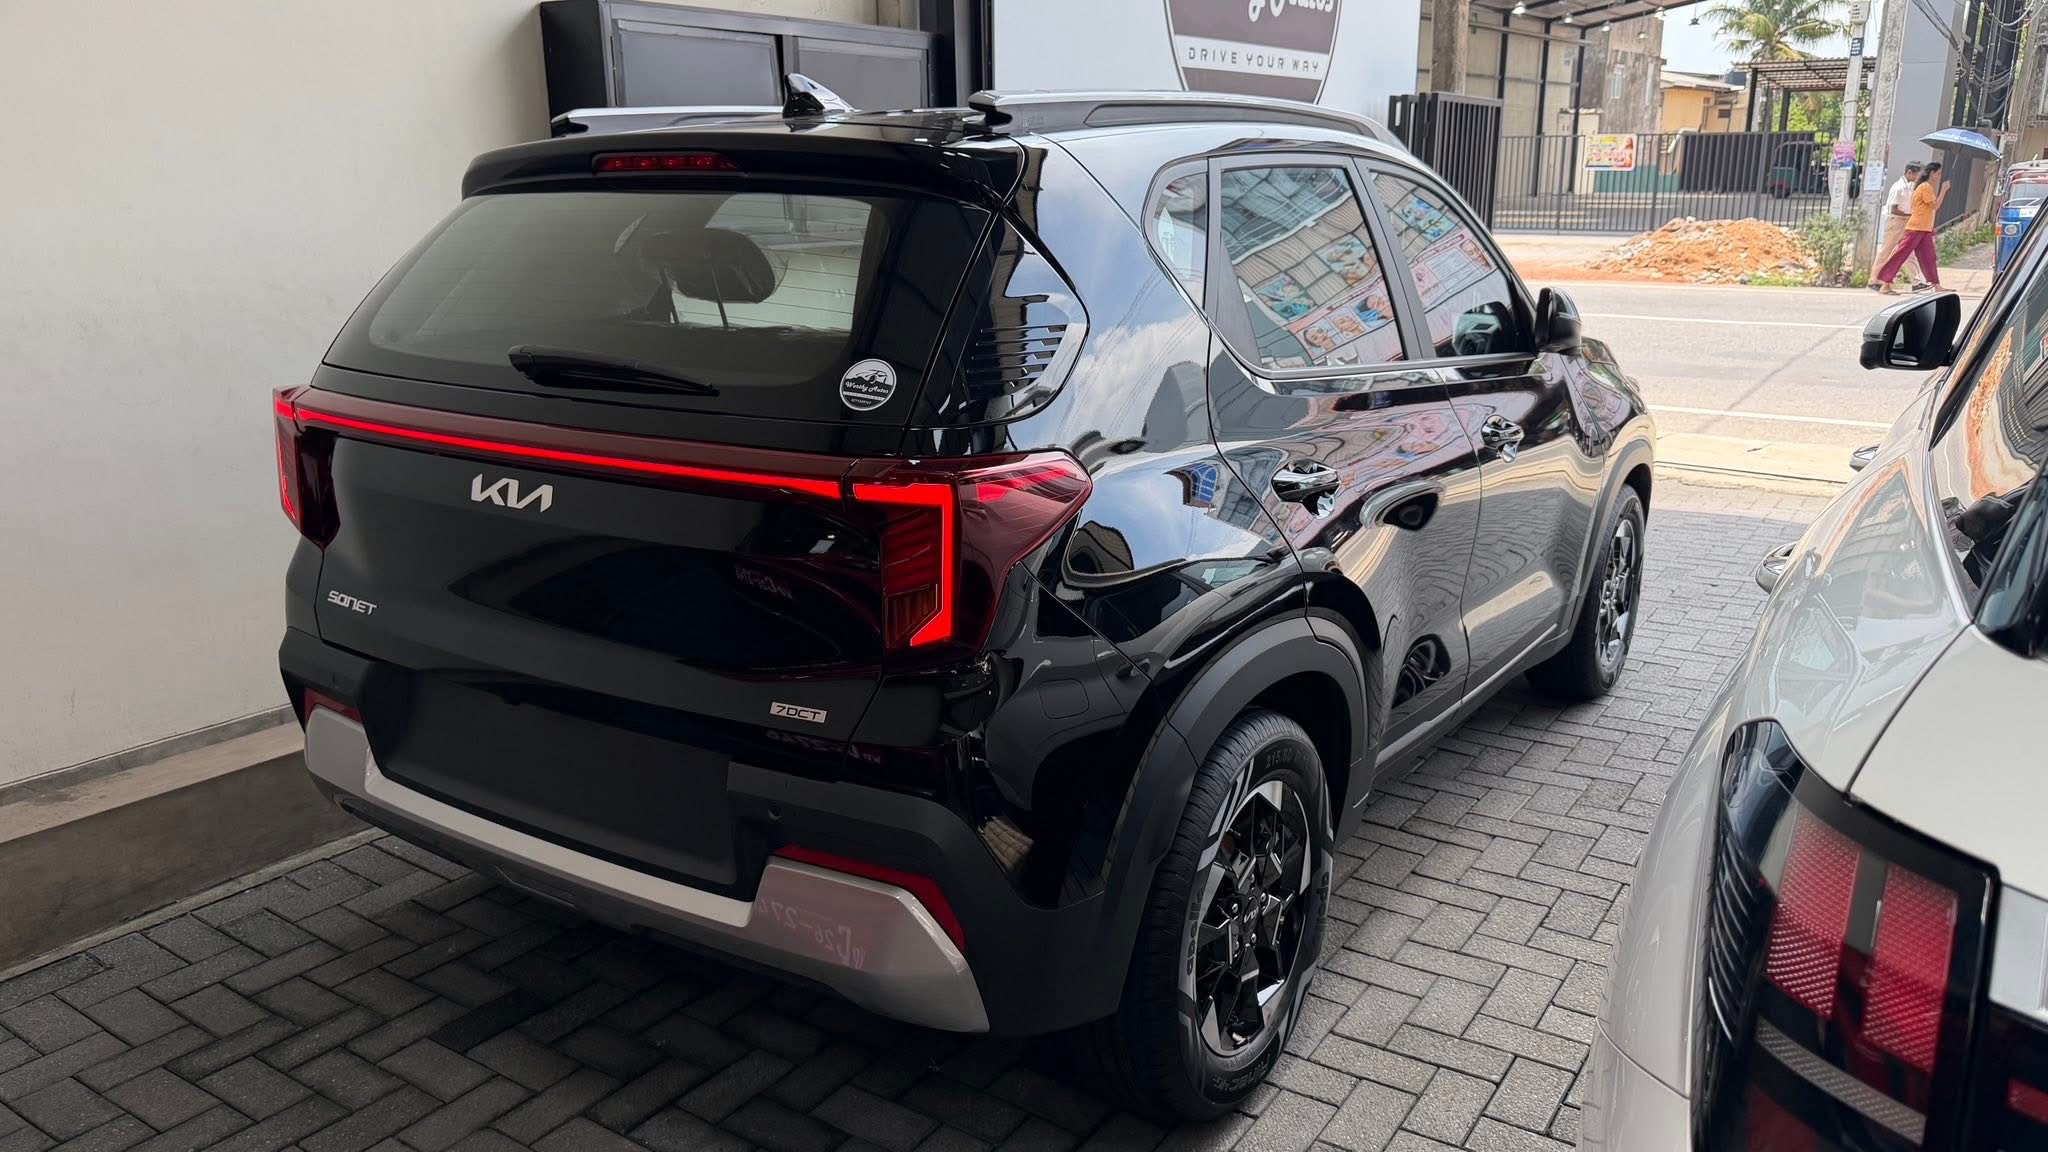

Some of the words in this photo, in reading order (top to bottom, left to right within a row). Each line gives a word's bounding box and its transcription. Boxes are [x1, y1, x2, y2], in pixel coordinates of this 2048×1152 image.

[1188, 47, 1237, 65] DRIVE
[1246, 54, 1285, 70] YOUR
[1291, 59, 1319, 73] WAY
[471, 473, 553, 512] KIA
[327, 590, 377, 616] SONET
[774, 704, 822, 721] 7DCT
